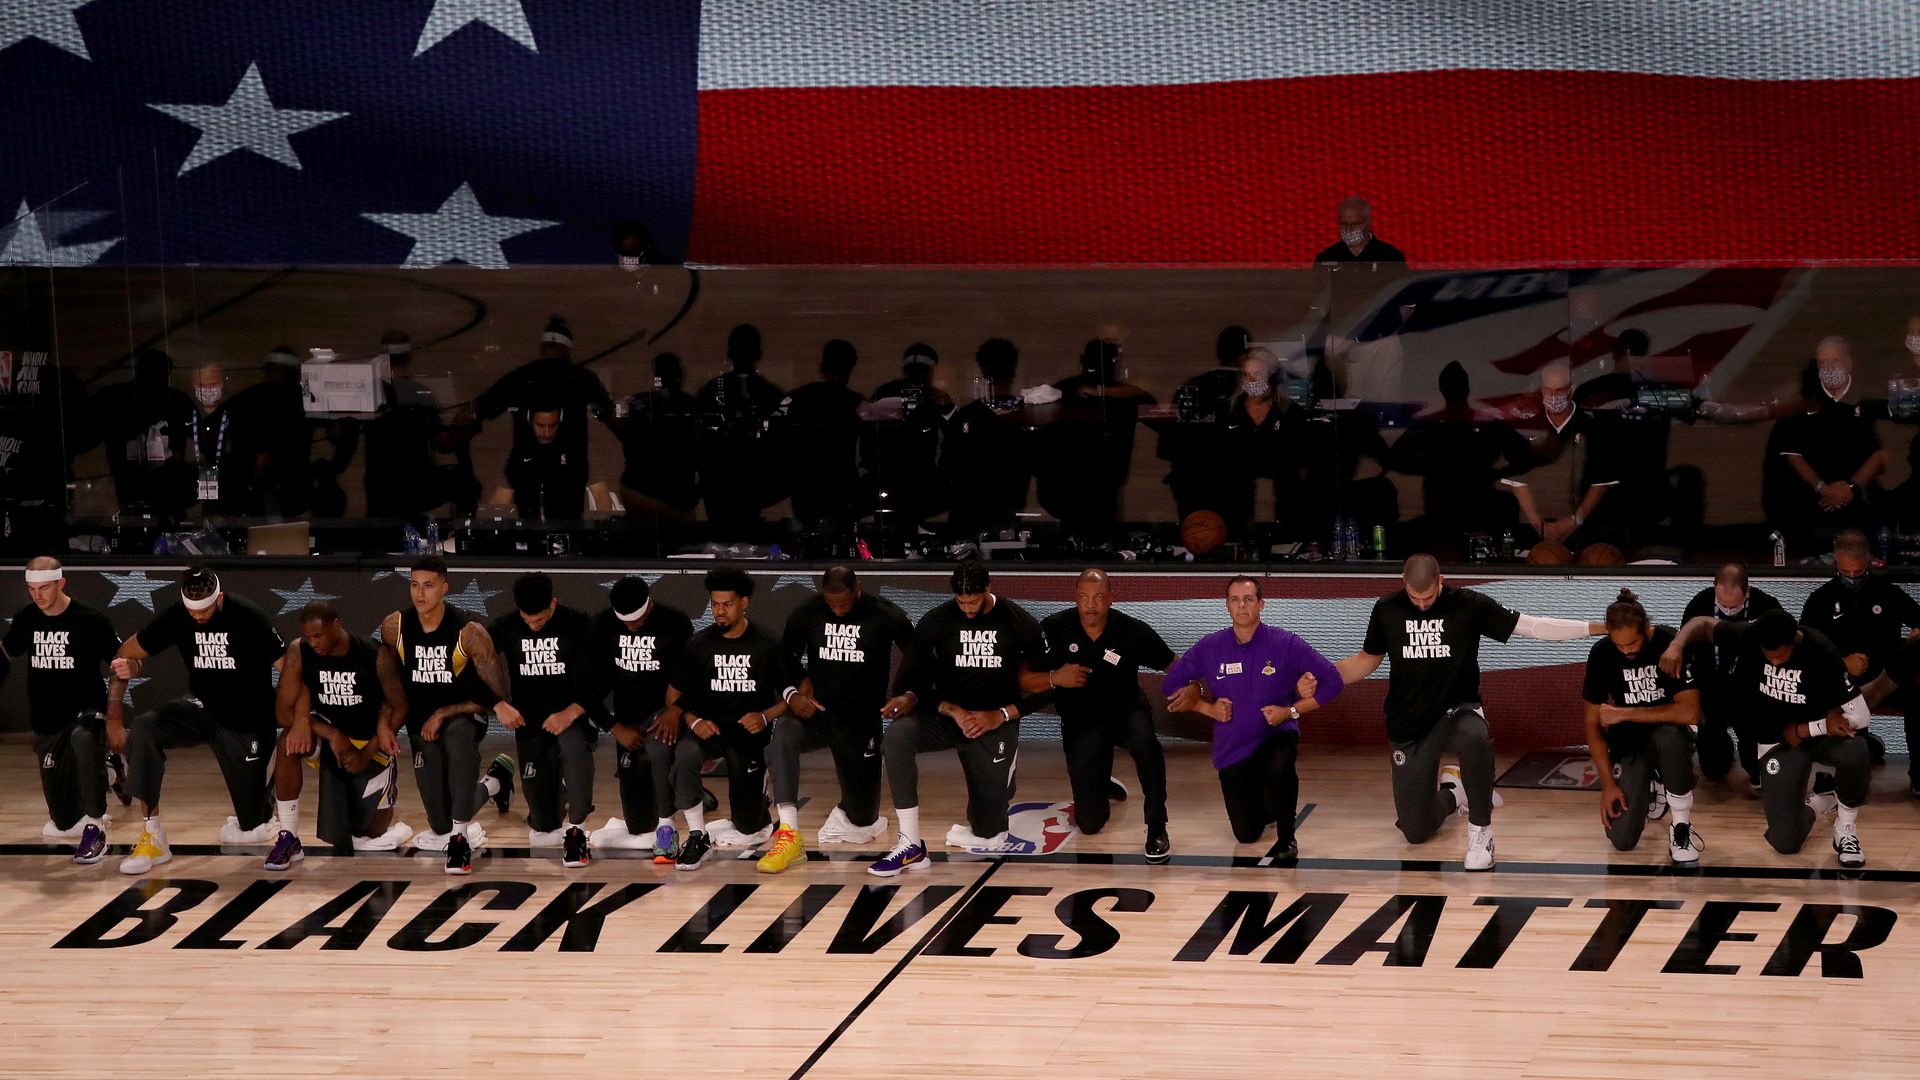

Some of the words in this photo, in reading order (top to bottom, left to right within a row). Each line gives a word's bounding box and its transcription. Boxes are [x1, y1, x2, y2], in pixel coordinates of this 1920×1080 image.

[825, 622, 861, 638] BLACK
[1405, 619, 1445, 633] BLACK
[34, 631, 69, 644] BLACK
[195, 632, 229, 645] BLACK
[521, 637, 559, 651] BLACK
[619, 634, 656, 649] BLACK
[827, 636, 856, 649] LIVES
[960, 630, 997, 644] BLACK
[1409, 632, 1441, 646] LIVES
[36, 644, 65, 656] LIVES
[199, 644, 227, 657] LIVES
[415, 645, 447, 659] BLACK
[621, 647, 652, 660] LIVES
[819, 647, 865, 663] MATTER
[963, 642, 994, 655] LIVES
[1402, 645, 1451, 659] MATTER
[32, 656, 74, 669] MATTER
[194, 656, 236, 669] MATTER
[418, 658, 446, 670] LIVES
[525, 651, 556, 664] LIVES
[615, 657, 660, 672] MATTER
[714, 654, 751, 668] BLACK
[955, 655, 1002, 668] MATTER
[519, 662, 565, 675] MATTER
[718, 667, 748, 680] LIVES
[1623, 665, 1658, 681] BLACK
[1763, 663, 1802, 683] BLACK
[319, 670, 356, 684] BLACK
[1766, 675, 1798, 693] LIVES
[323, 683, 354, 695] LIVES
[711, 679, 756, 692] MATTER
[1628, 677, 1657, 693] LIVES
[318, 693, 363, 706] MATTER
[1759, 682, 1807, 704] MATTER
[50, 879, 666, 953] BLACK
[655, 883, 1156, 959] LIVES
[1171, 890, 1899, 979] MATTER
